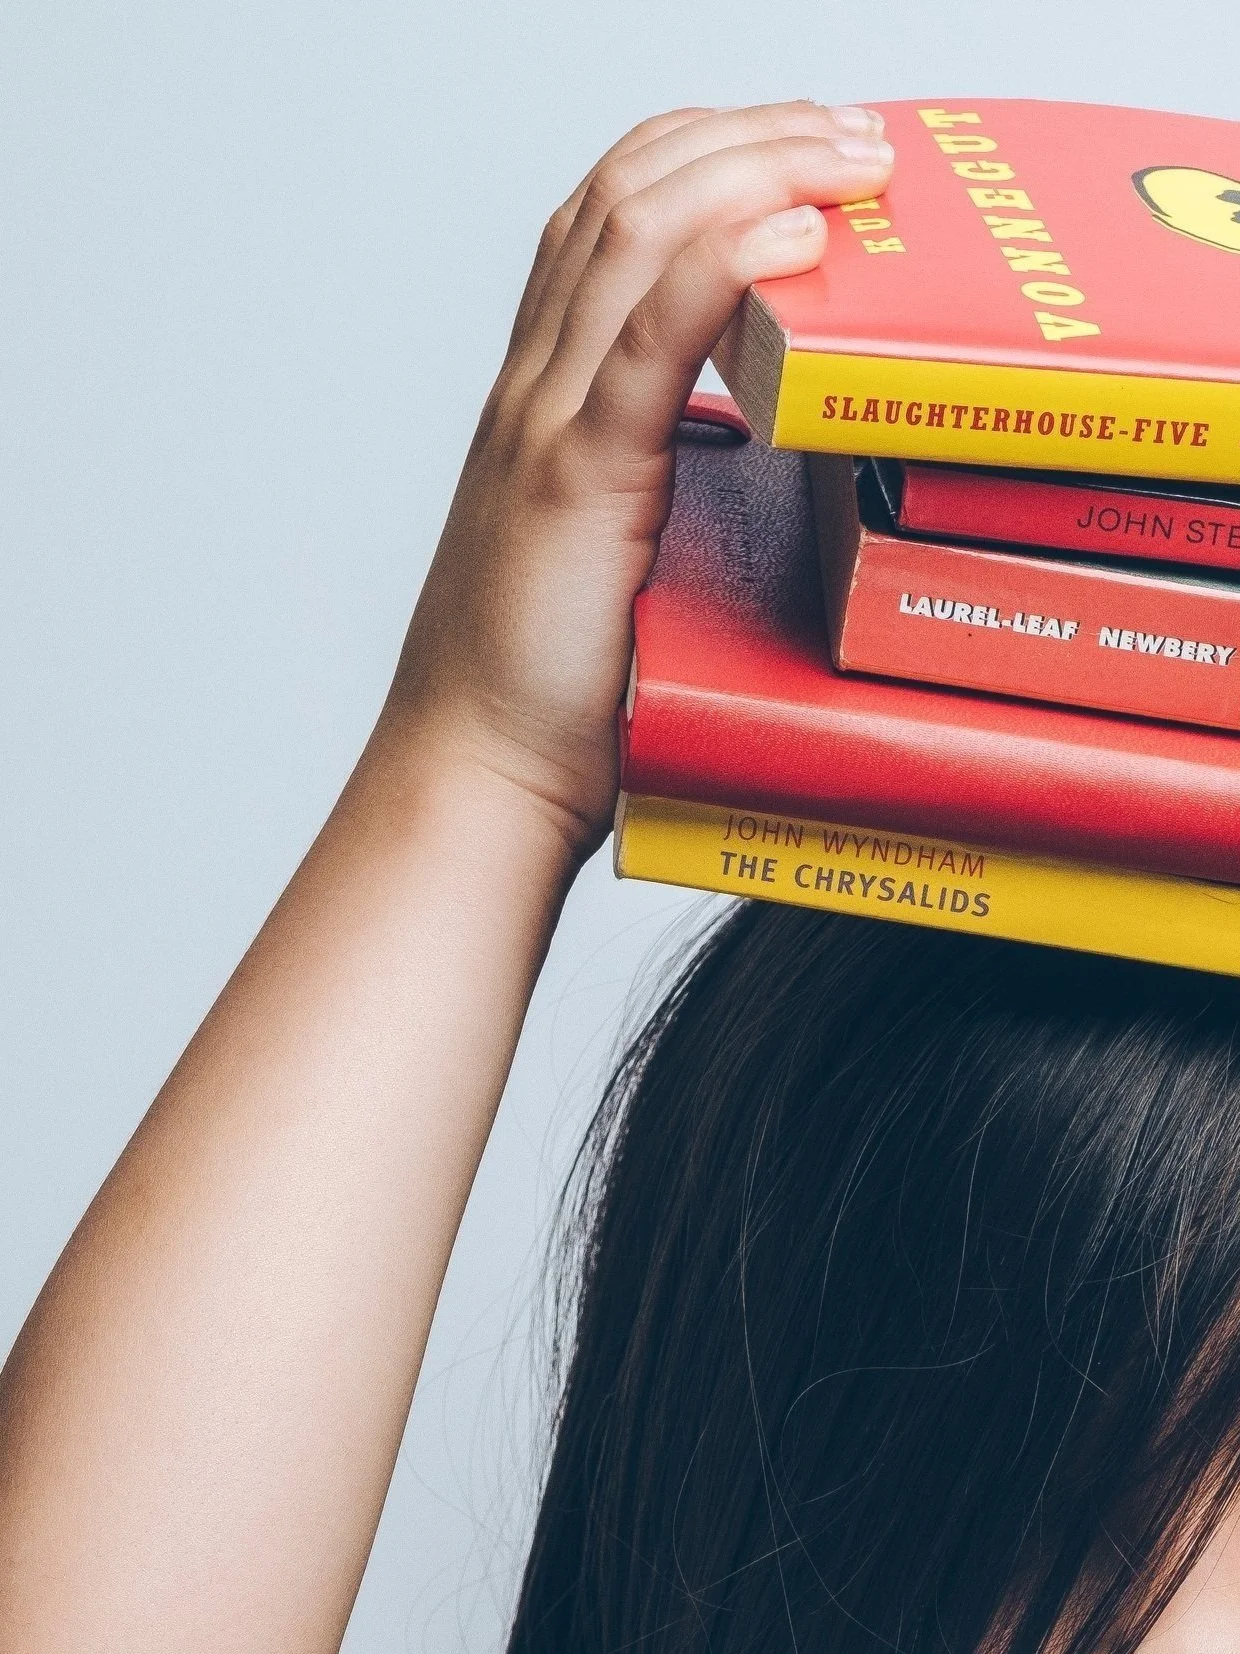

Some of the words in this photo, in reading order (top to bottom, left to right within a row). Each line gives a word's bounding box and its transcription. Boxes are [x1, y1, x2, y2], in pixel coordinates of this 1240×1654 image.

[840, 198, 907, 254] KUR
[916, 108, 1102, 341] VONNEGUT
[821, 394, 1210, 448] SLAUGHTERHOUSE-FIVE
[1076, 505, 1174, 540] JOHN
[899, 593, 1080, 642] LAUREL-LEAF
[1098, 626, 1238, 667] NEWBERY
[723, 814, 805, 848] JOHN
[822, 829, 986, 880] WYNDHAM
[719, 850, 776, 883] THE
[793, 863, 992, 918] CHRYSALIDS
